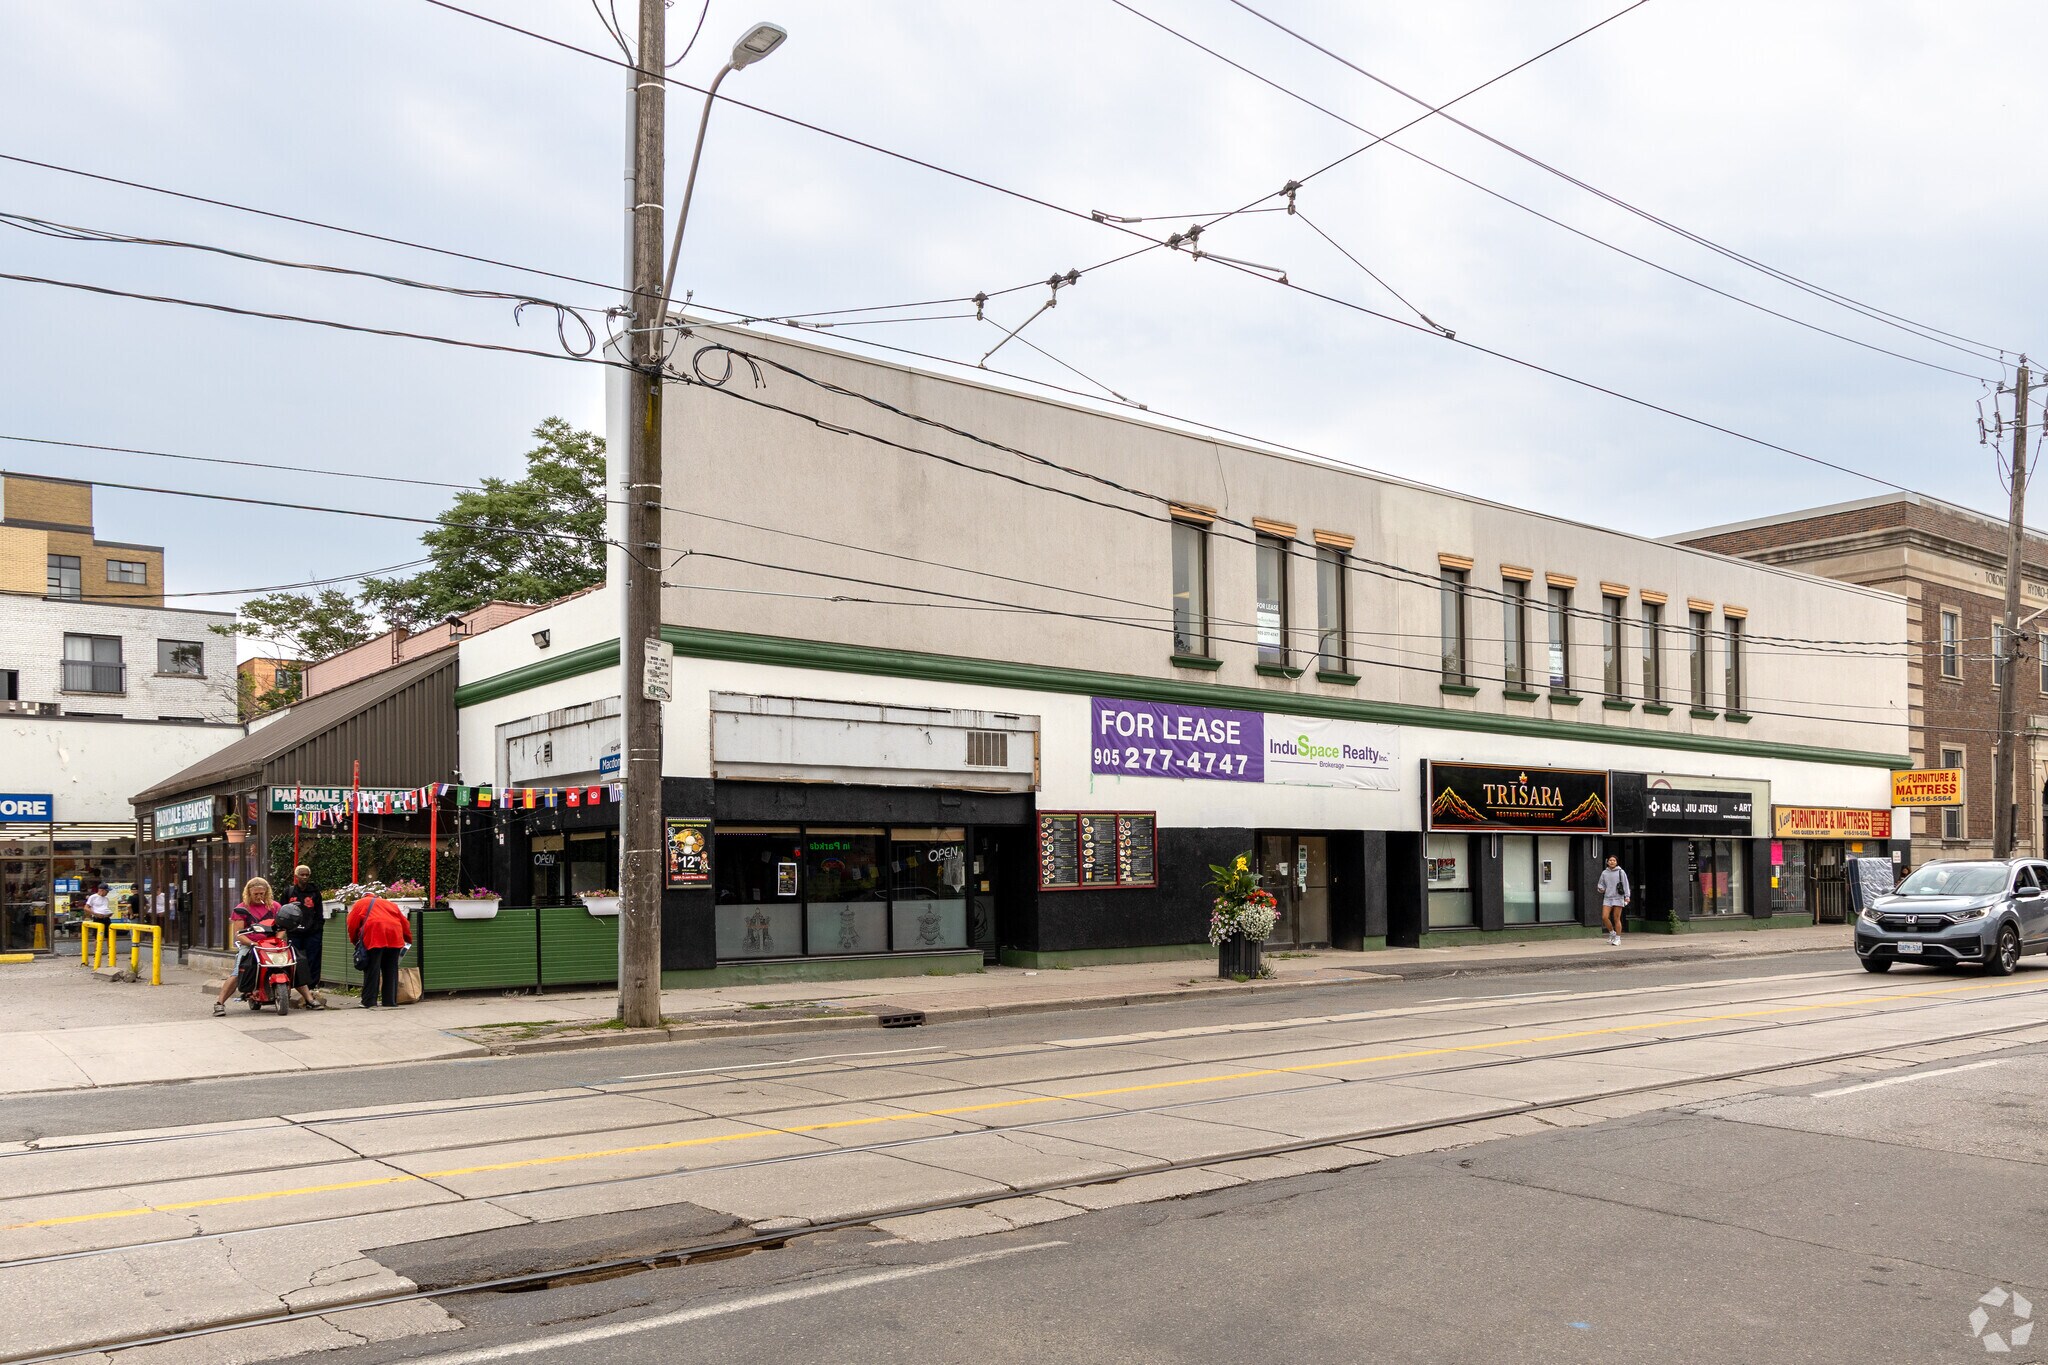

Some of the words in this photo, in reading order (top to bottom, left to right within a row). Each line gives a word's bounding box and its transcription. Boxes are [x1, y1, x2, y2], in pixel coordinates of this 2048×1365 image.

[1266, 603, 1279, 611] LEASE
[1101, 709, 1154, 738] FOR
[1163, 714, 1241, 745] LEASE
[1270, 735, 1339, 759] InduSpace
[1342, 744, 1379, 763] Realty
[1094, 748, 1120, 766] 905
[1125, 747, 1248, 775] 277-4747
[1319, 761, 1345, 770] Brokerage
[1908, 773, 1949, 783] FURNITURE
[1951, 772, 1957, 782] &
[275, 789, 340, 802] PARKDALE
[1896, 784, 1957, 795] MATTRESS
[0, 800, 47, 815] ORE
[1662, 803, 1681, 813] KASA
[1685, 804, 1697, 813] JIU
[1698, 804, 1718, 813] JITSU
[1739, 803, 1752, 812] ART
[1791, 810, 1828, 829] FURNITURE
[1829, 811, 1835, 829] &
[1836, 811, 1870, 830] MATTRESS
[534, 854, 555, 866] OPEN
[928, 846, 958, 862] OPEN
